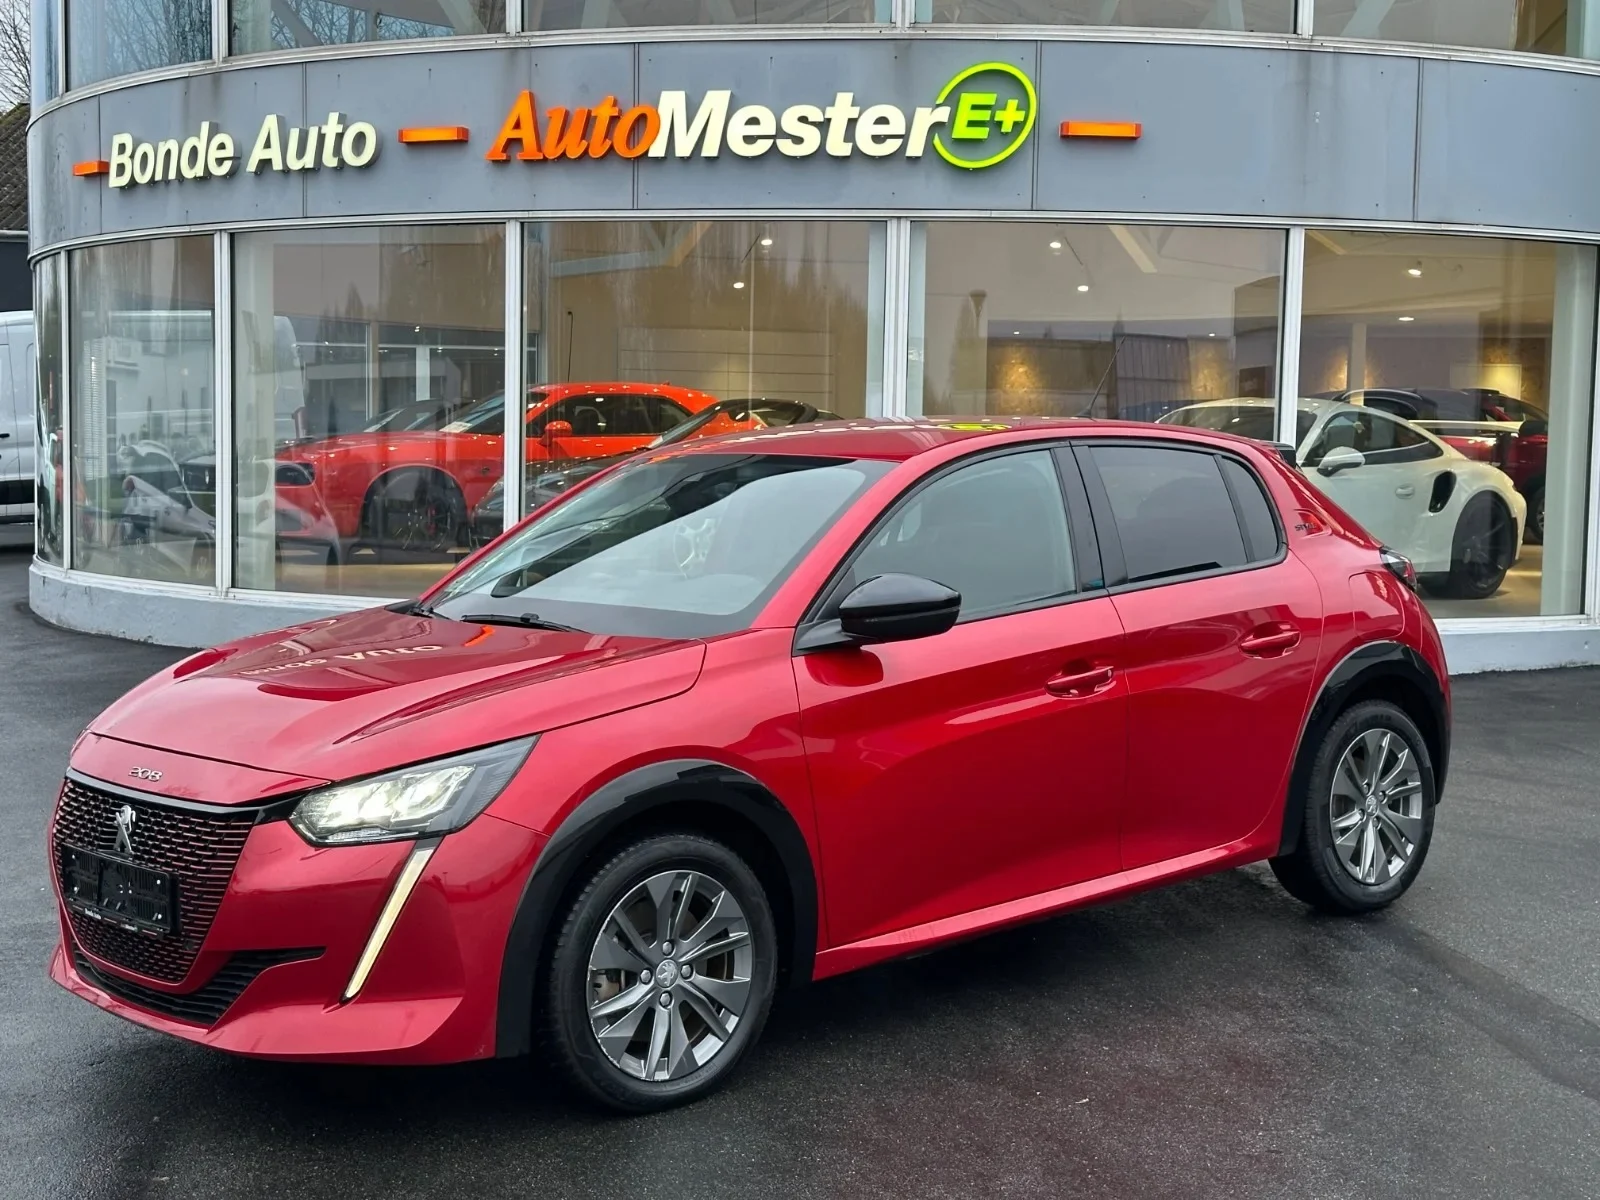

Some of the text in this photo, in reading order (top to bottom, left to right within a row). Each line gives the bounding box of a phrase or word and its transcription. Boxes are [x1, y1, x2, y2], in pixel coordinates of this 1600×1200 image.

[108, 111, 379, 189] Bonde Auto
[485, 89, 951, 161] AutoMester
[128, 766, 163, 782] 208
